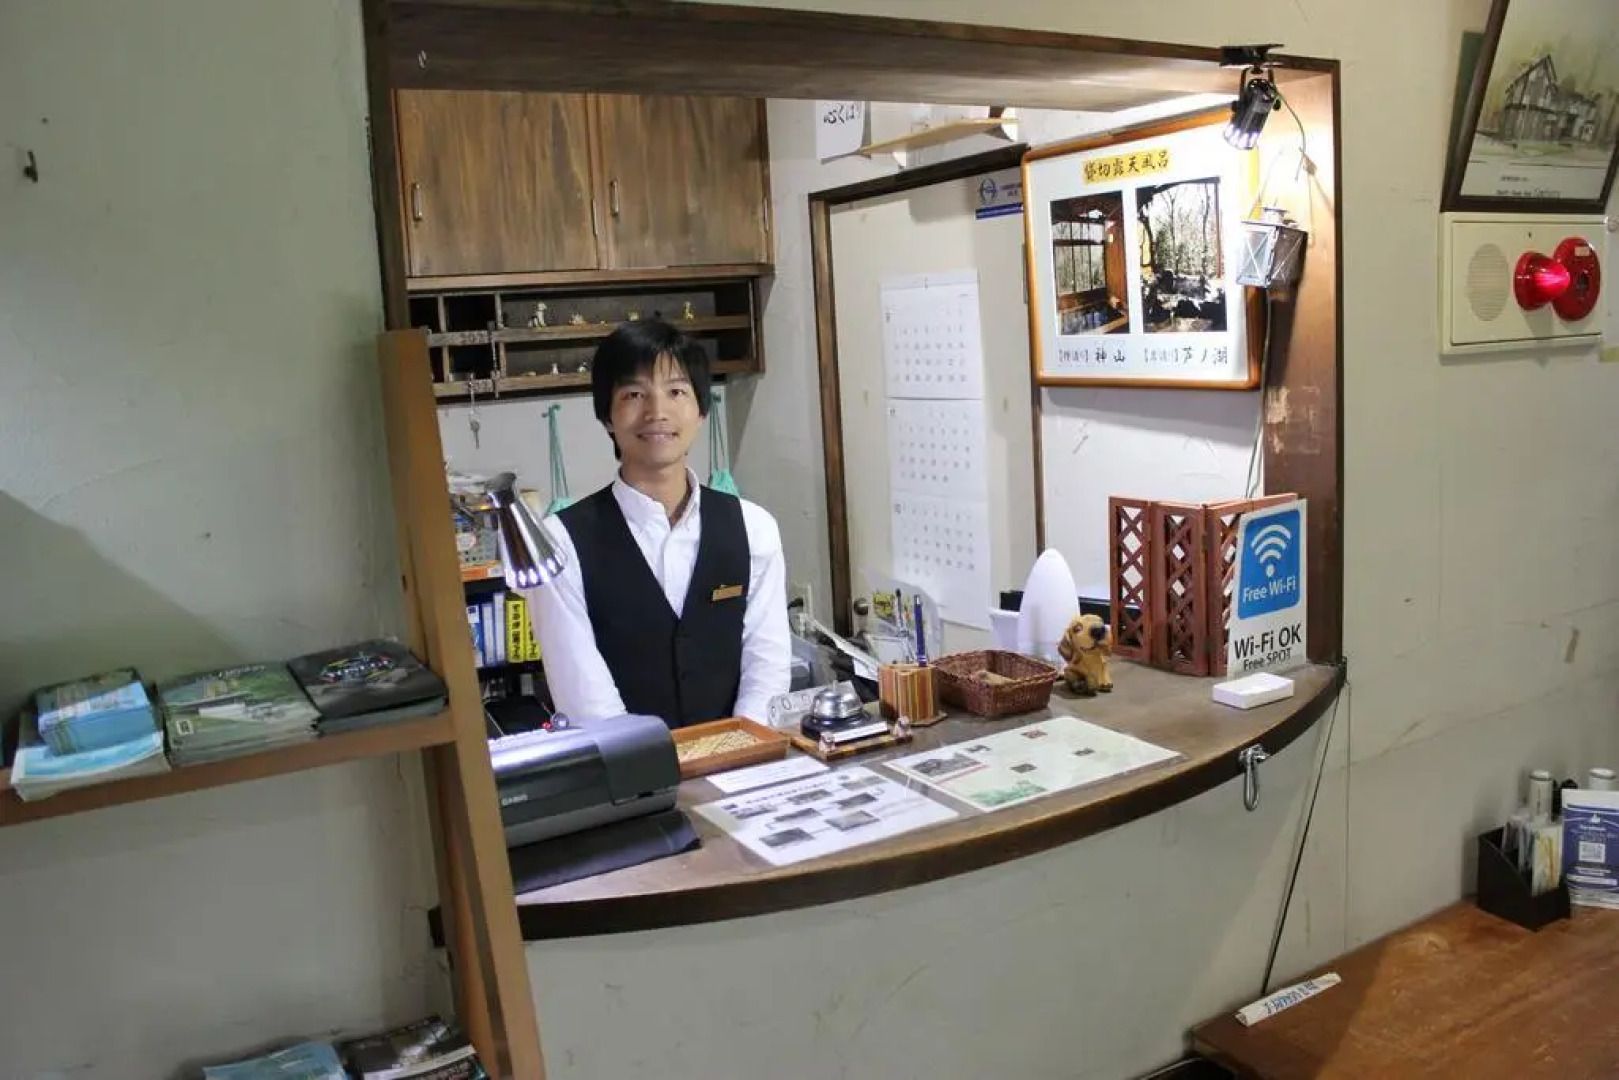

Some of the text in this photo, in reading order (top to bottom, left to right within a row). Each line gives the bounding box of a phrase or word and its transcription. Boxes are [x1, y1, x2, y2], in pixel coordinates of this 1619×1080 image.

[1242, 576, 1296, 603] Free Wi-Fi
[1234, 623, 1302, 660] Wi-Fi OK
[1243, 647, 1292, 672] Free SPOT
